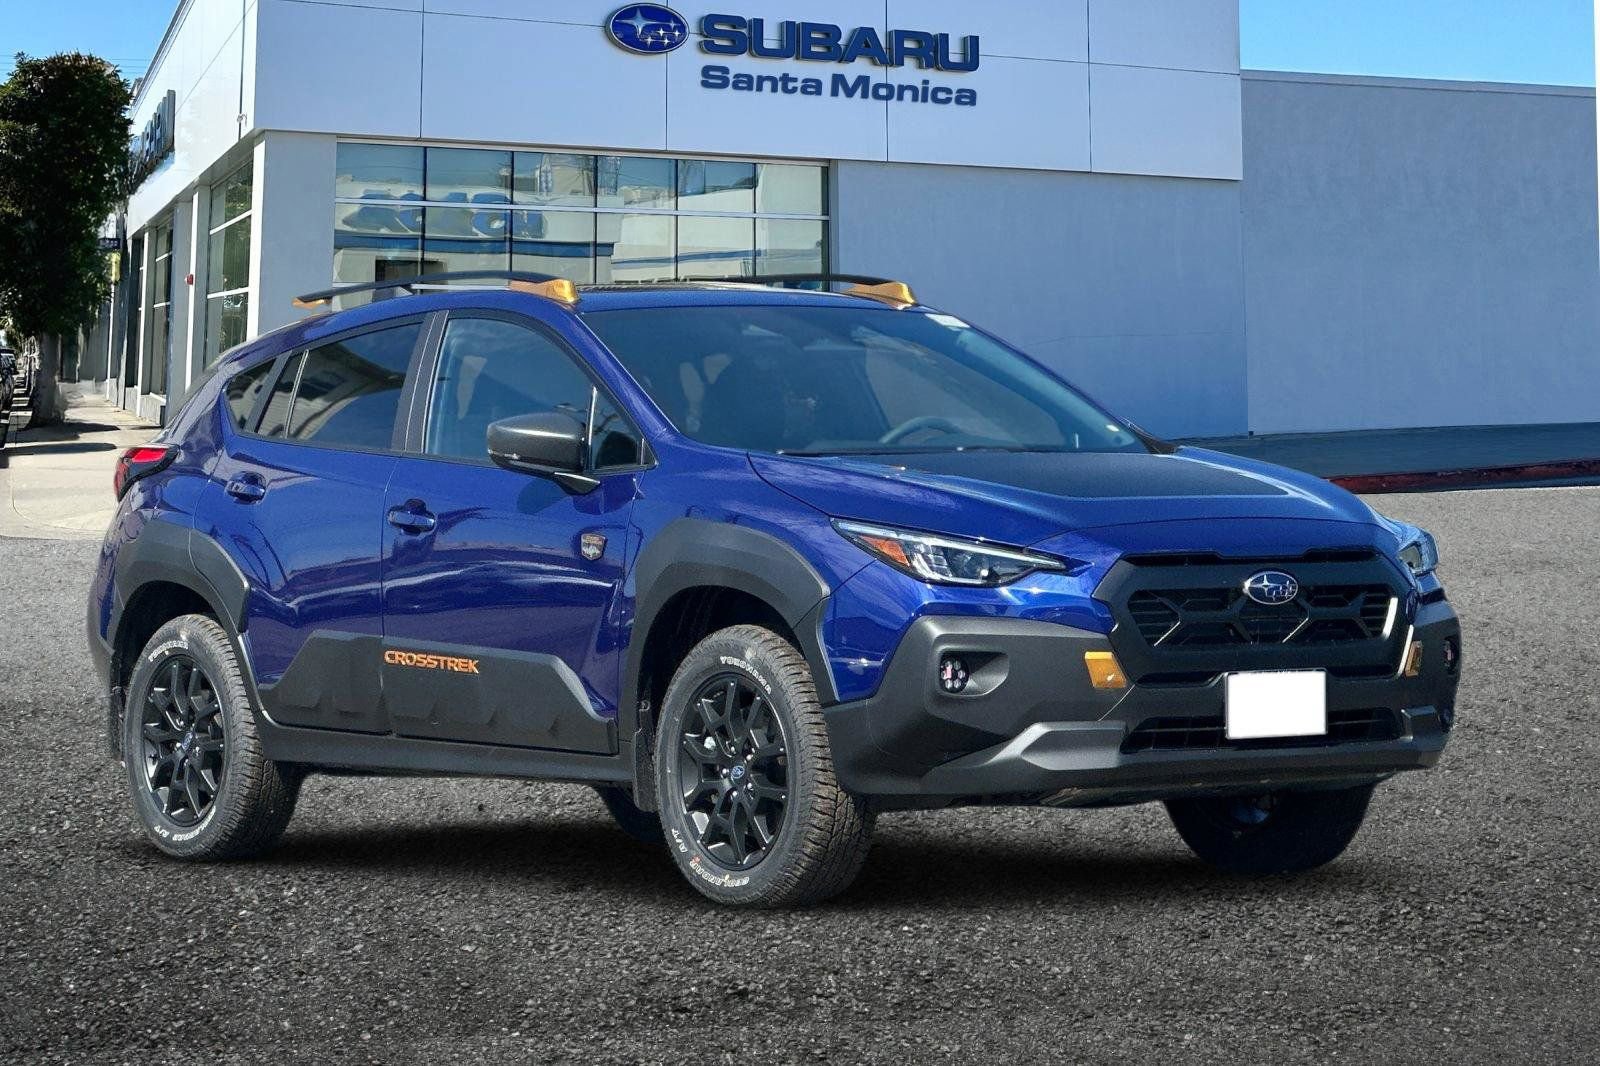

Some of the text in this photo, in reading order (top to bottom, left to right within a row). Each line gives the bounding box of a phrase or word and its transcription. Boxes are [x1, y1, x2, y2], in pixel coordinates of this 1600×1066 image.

[699, 13, 980, 72] SUBARU
[700, 64, 978, 107] Santa Monica
[384, 651, 479, 673] CROSSTREK
